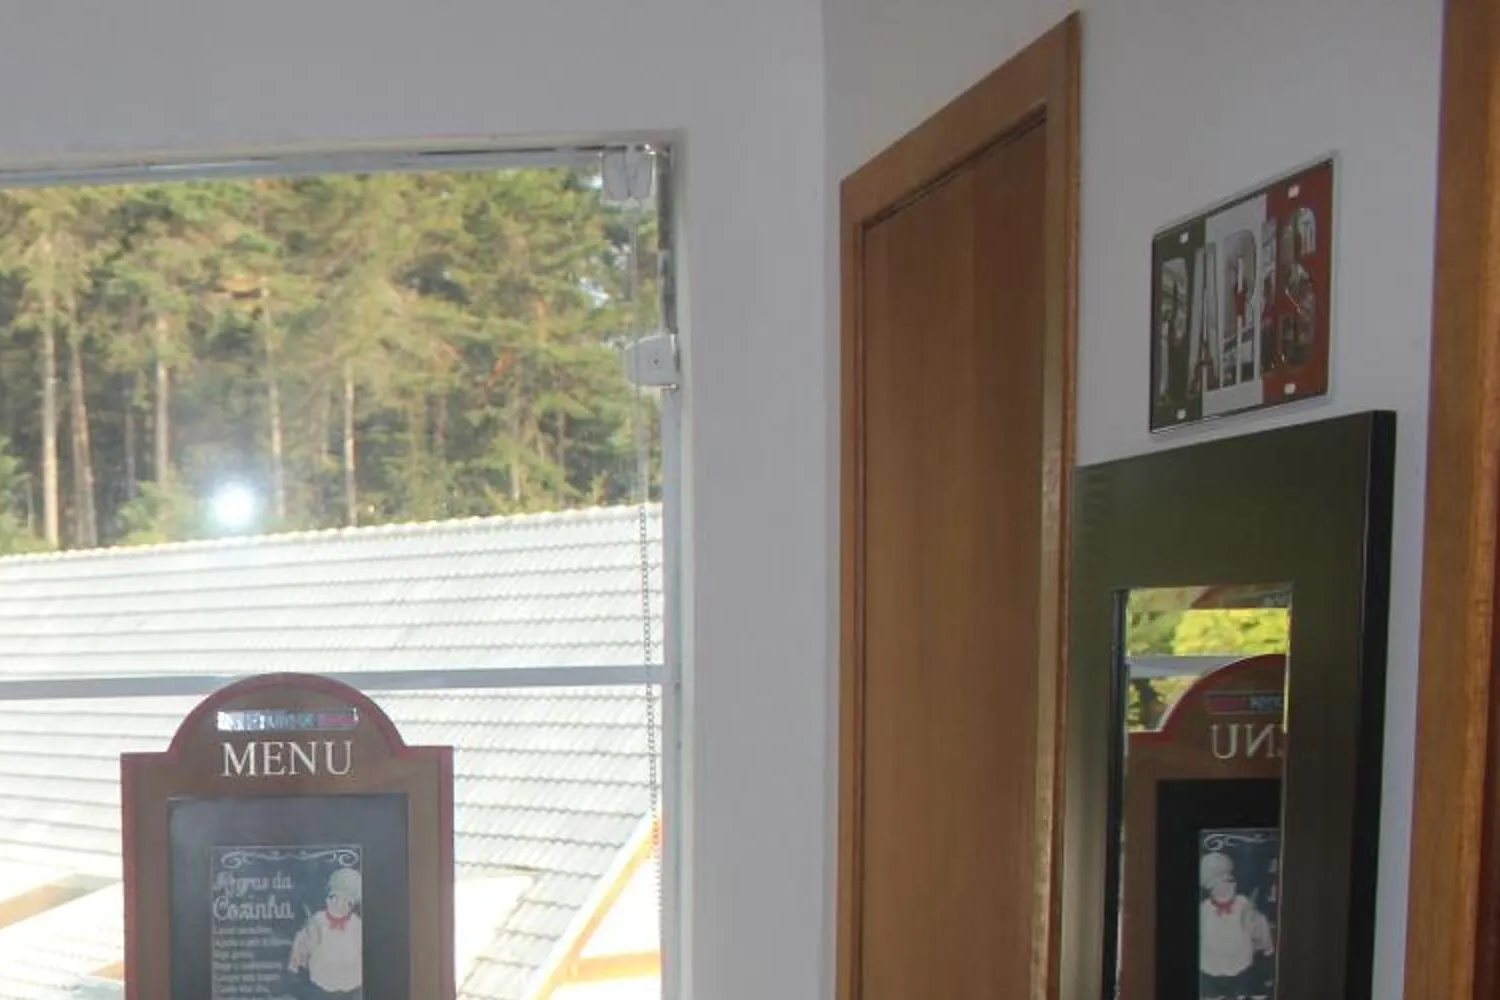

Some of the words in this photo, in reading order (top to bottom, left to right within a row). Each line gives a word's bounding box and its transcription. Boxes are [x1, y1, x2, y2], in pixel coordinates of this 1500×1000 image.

[1160, 206, 1318, 404] PARIS
[220, 740, 353, 777] MENU
[271, 869, 296, 890] da
[212, 894, 296, 921] Cozinha
